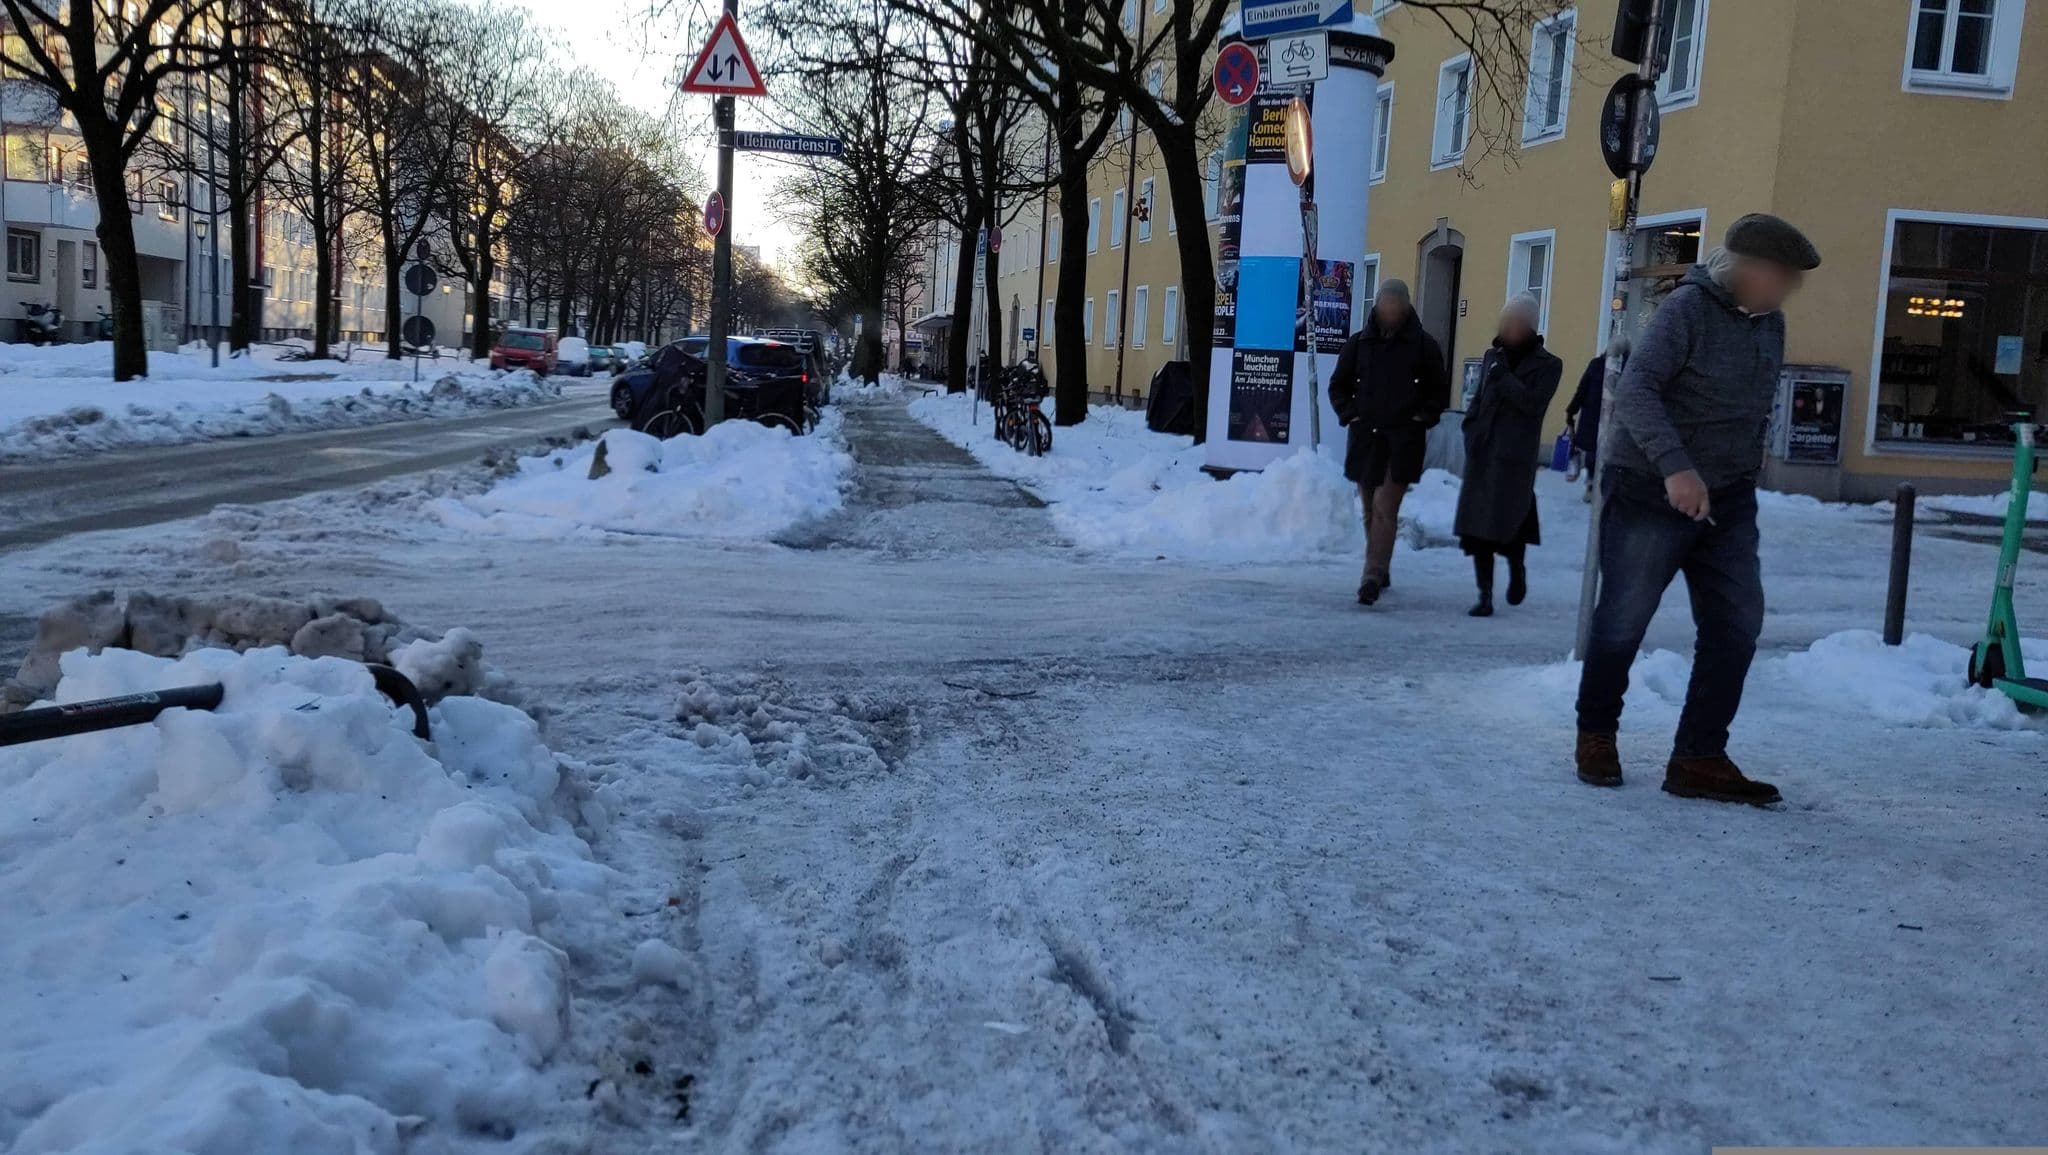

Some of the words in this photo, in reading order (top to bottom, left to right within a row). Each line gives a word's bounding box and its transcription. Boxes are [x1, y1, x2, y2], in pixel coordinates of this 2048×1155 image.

[1247, 1, 1320, 22] Einbahnstraße
[743, 133, 837, 153] Heimgartenstr.
[1215, 292, 1235, 305] SPEL
[1315, 325, 1343, 335] ünchen
[1243, 354, 1280, 364] München
[1243, 362, 1278, 372] leuchtet!
[1246, 376, 1288, 386] Jakobsplatz
